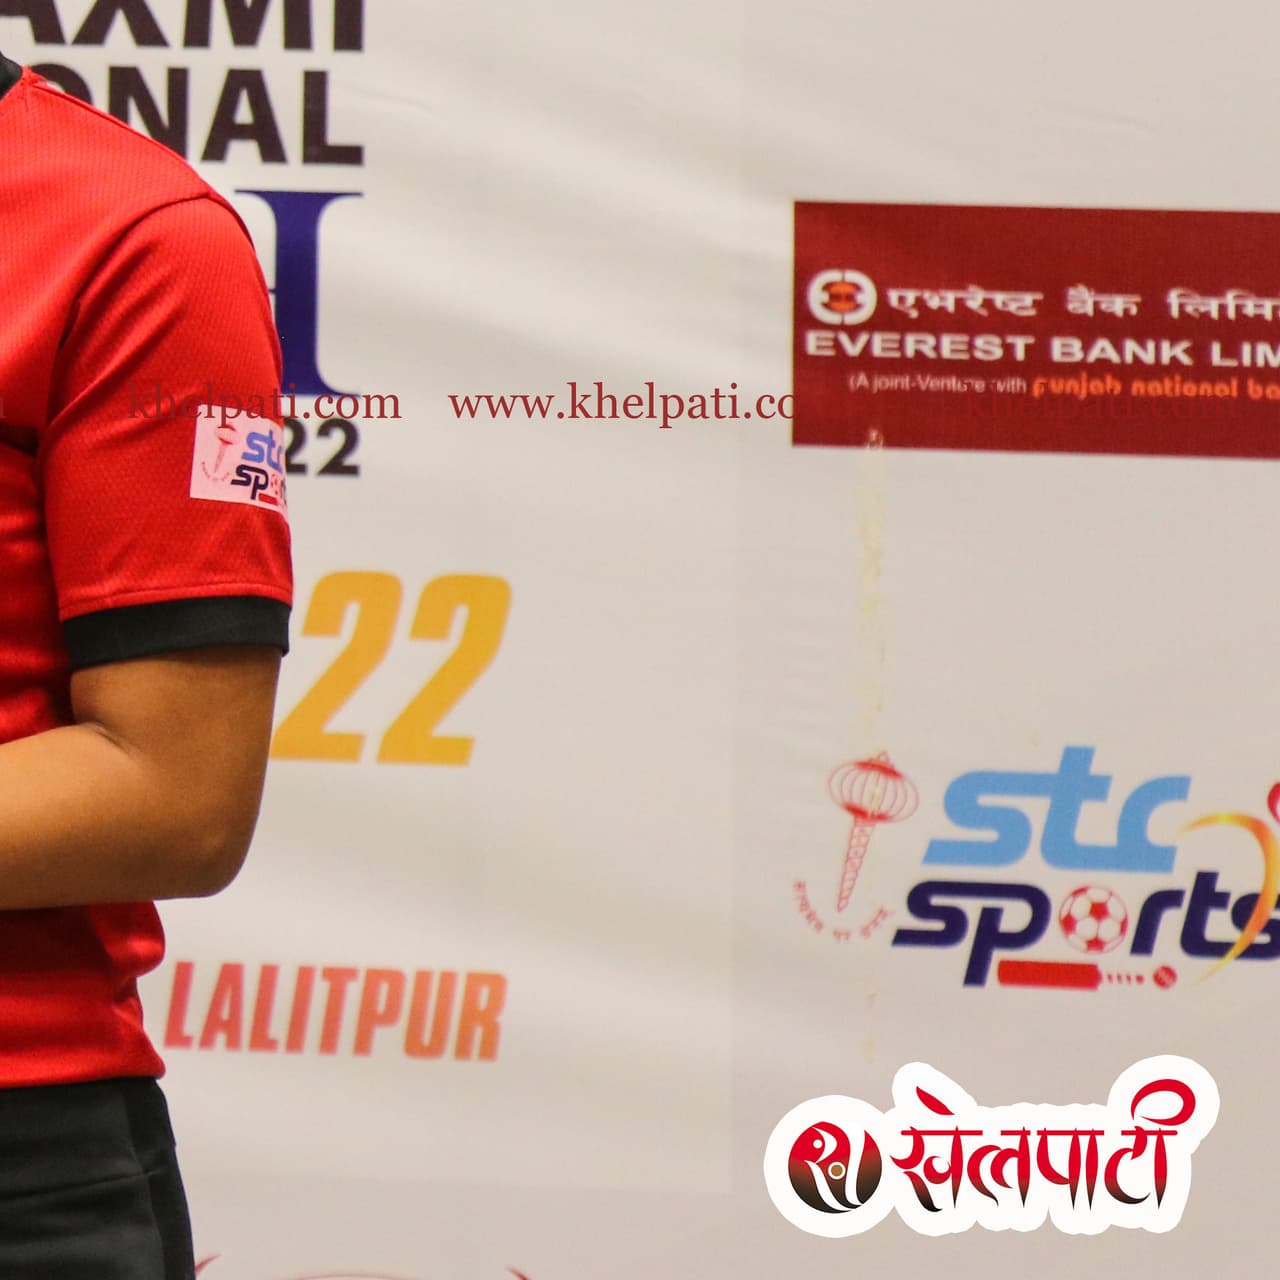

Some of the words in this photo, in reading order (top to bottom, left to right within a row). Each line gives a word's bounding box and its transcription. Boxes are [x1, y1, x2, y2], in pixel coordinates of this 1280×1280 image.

[804, 330, 1036, 363] EVEREST
[1051, 336, 1194, 366] BANK
[1130, 373, 1239, 400] national
[922, 746, 1192, 874] stc
[162, 960, 508, 1062] LALITPUR
